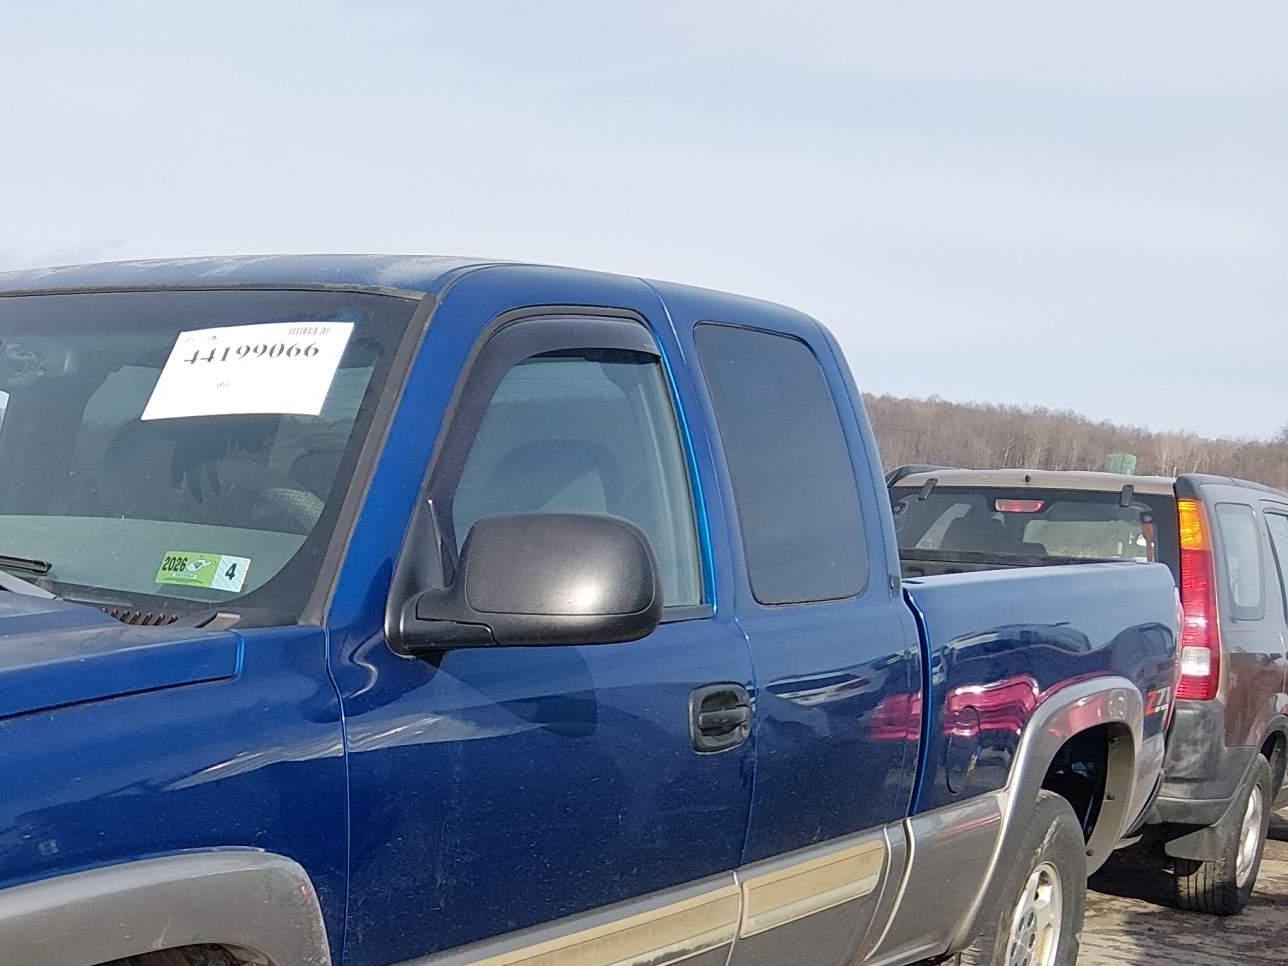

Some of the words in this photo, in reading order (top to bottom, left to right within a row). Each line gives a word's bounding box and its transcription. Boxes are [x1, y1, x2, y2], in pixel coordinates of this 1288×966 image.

[184, 341, 320, 365] 44199066
[161, 556, 188, 573] 2026
[224, 562, 237, 580] 4
